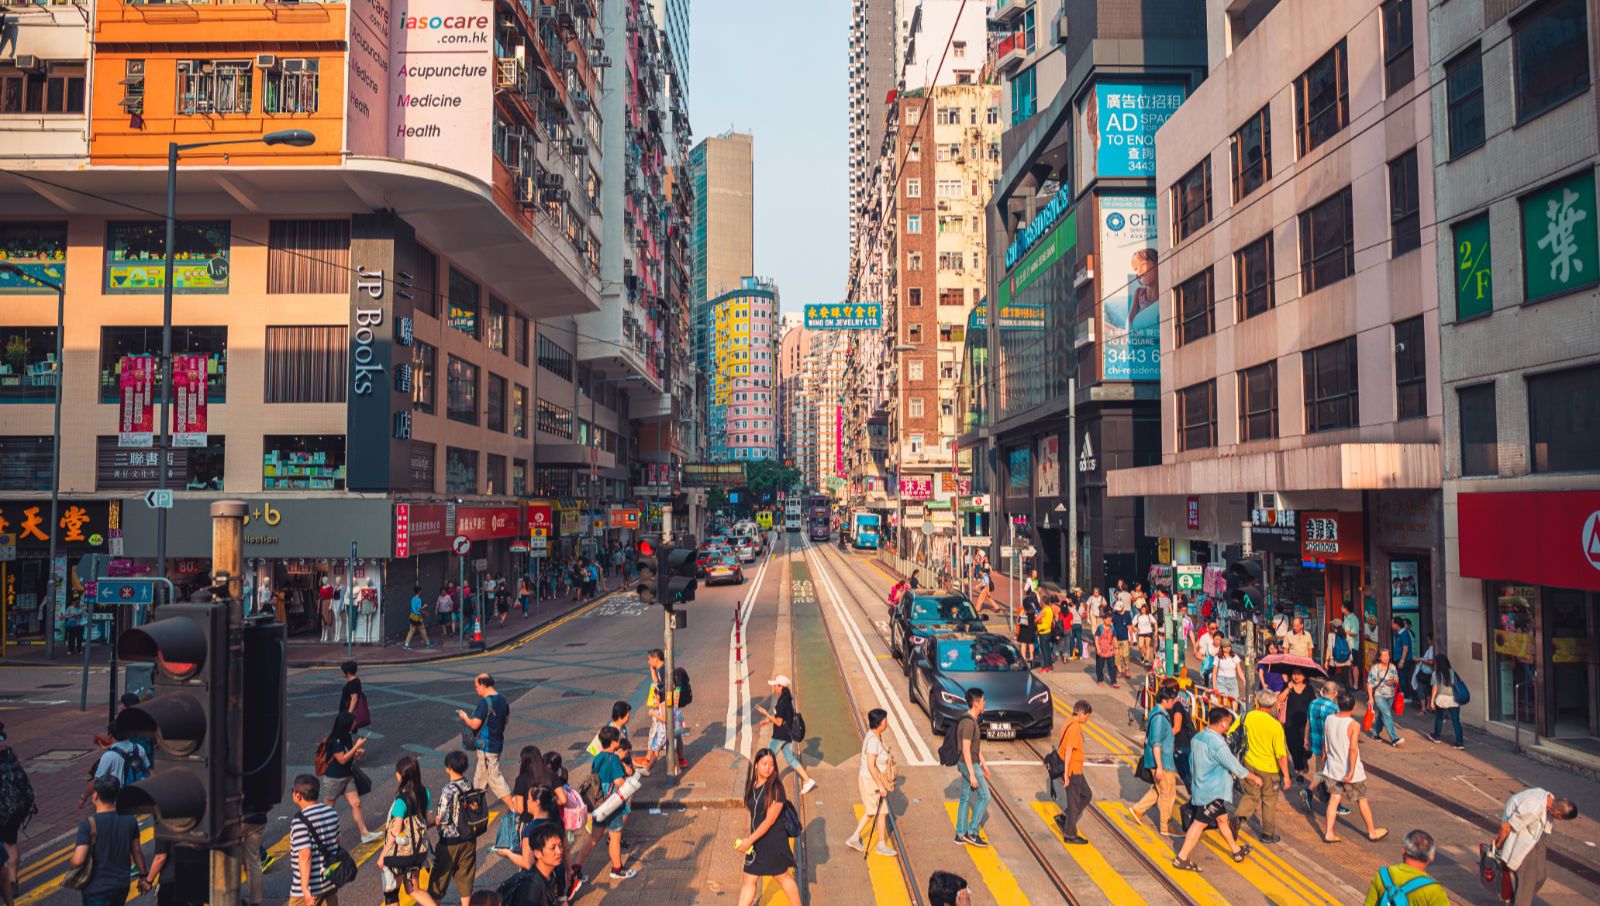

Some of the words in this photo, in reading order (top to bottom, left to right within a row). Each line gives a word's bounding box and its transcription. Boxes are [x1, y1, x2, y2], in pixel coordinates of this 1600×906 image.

[369, 14, 388, 37] .com.hk
[400, 12, 488, 30] iasocare
[437, 32, 487, 44] .com.hk
[352, 26, 388, 72] Acupuncture
[351, 58, 378, 94] Medicine
[398, 64, 487, 80] Acupuncture
[350, 90, 370, 118] Health
[397, 94, 461, 108] Medicine
[1106, 94, 1180, 109] 廣告位招租
[1106, 113, 1138, 132] AD
[397, 124, 441, 138] Health
[1107, 135, 1123, 145] TO
[1128, 148, 1154, 159] 查詢
[1128, 161, 1155, 171] 3443
[1130, 213, 1156, 227] CHI
[1460, 240, 1491, 299] 2/F
[357, 265, 384, 299] JP
[355, 306, 386, 395] Books
[1108, 349, 1147, 363] 3443
[160, 492, 169, 505] P
